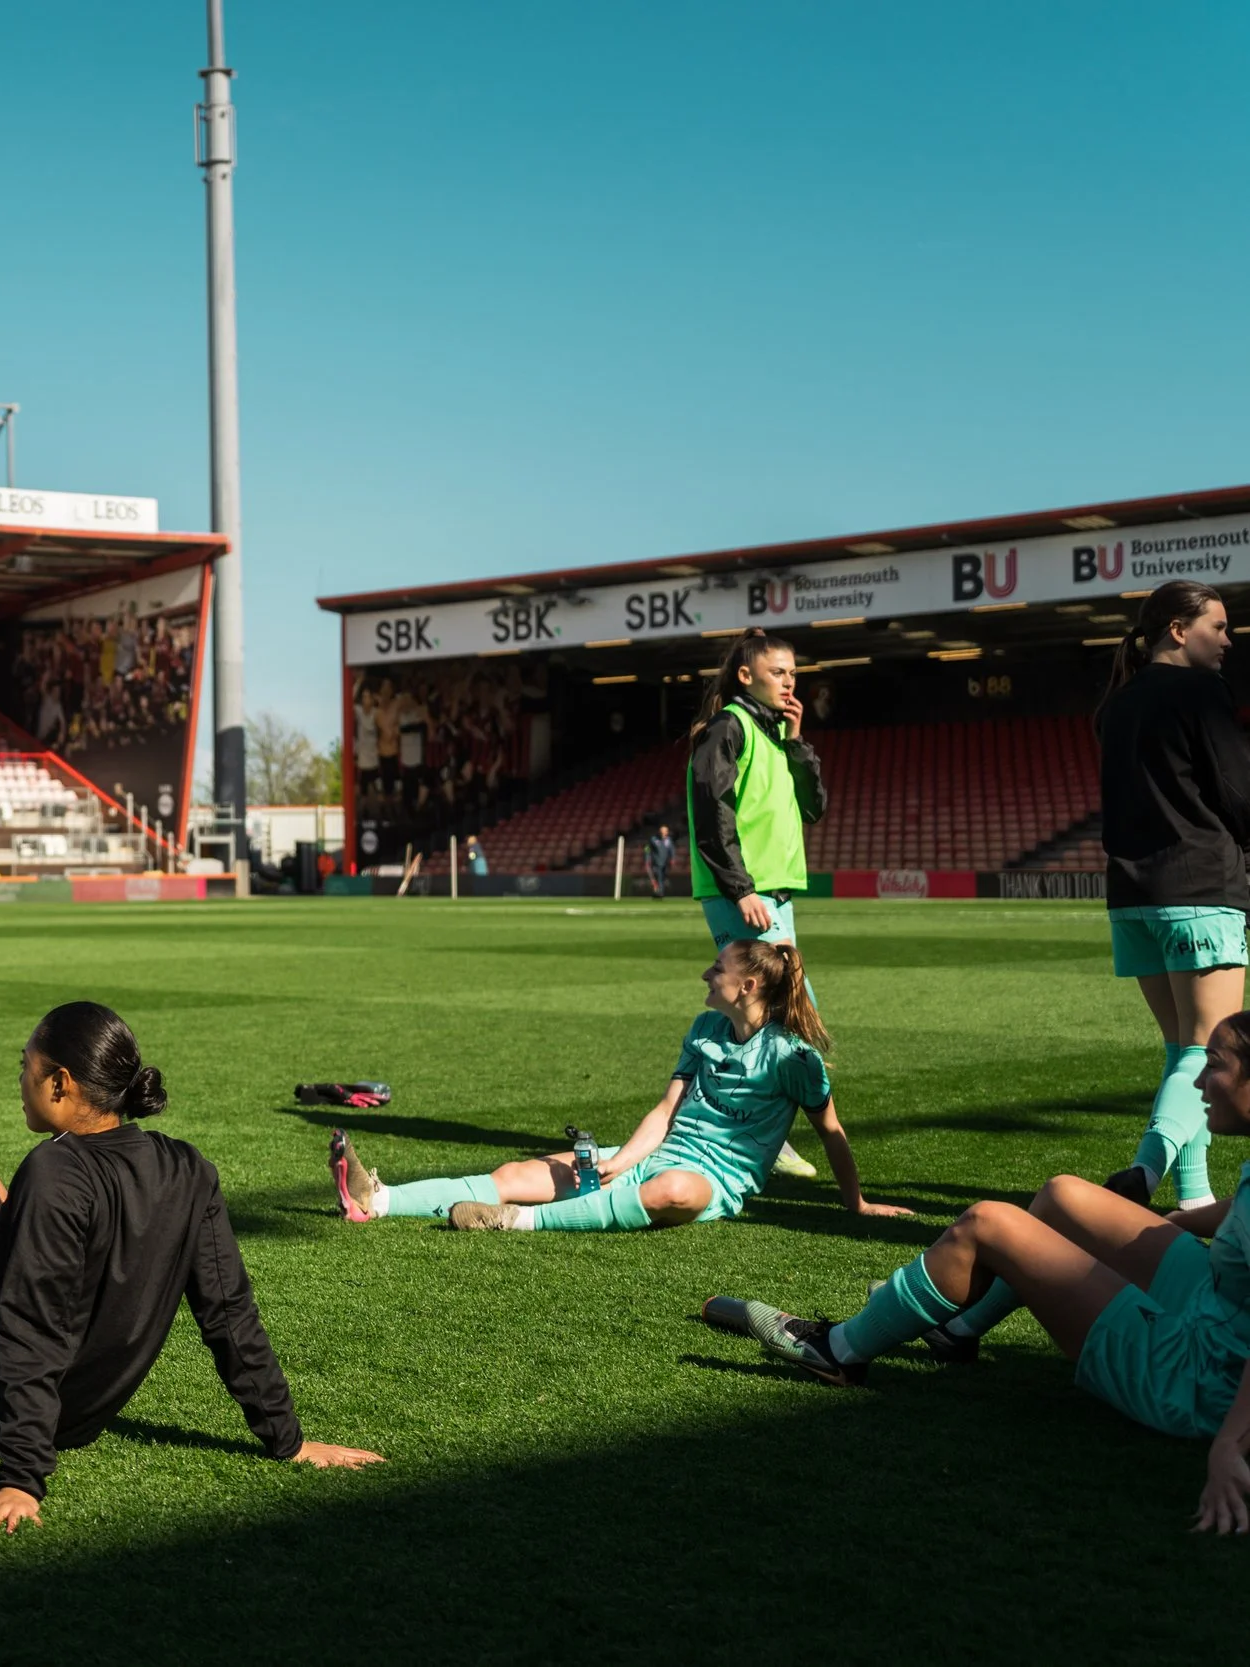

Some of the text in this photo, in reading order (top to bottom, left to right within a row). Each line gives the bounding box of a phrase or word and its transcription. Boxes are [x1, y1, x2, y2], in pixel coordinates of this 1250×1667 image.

[92, 500, 140, 521] LEOS
[1130, 527, 1250, 557] Bournemout
[952, 547, 1018, 602] BU
[1073, 538, 1123, 583] BU
[1132, 549, 1232, 578] University
[795, 565, 900, 593] Bournemouth
[748, 580, 789, 616] BU
[794, 590, 874, 613] University
